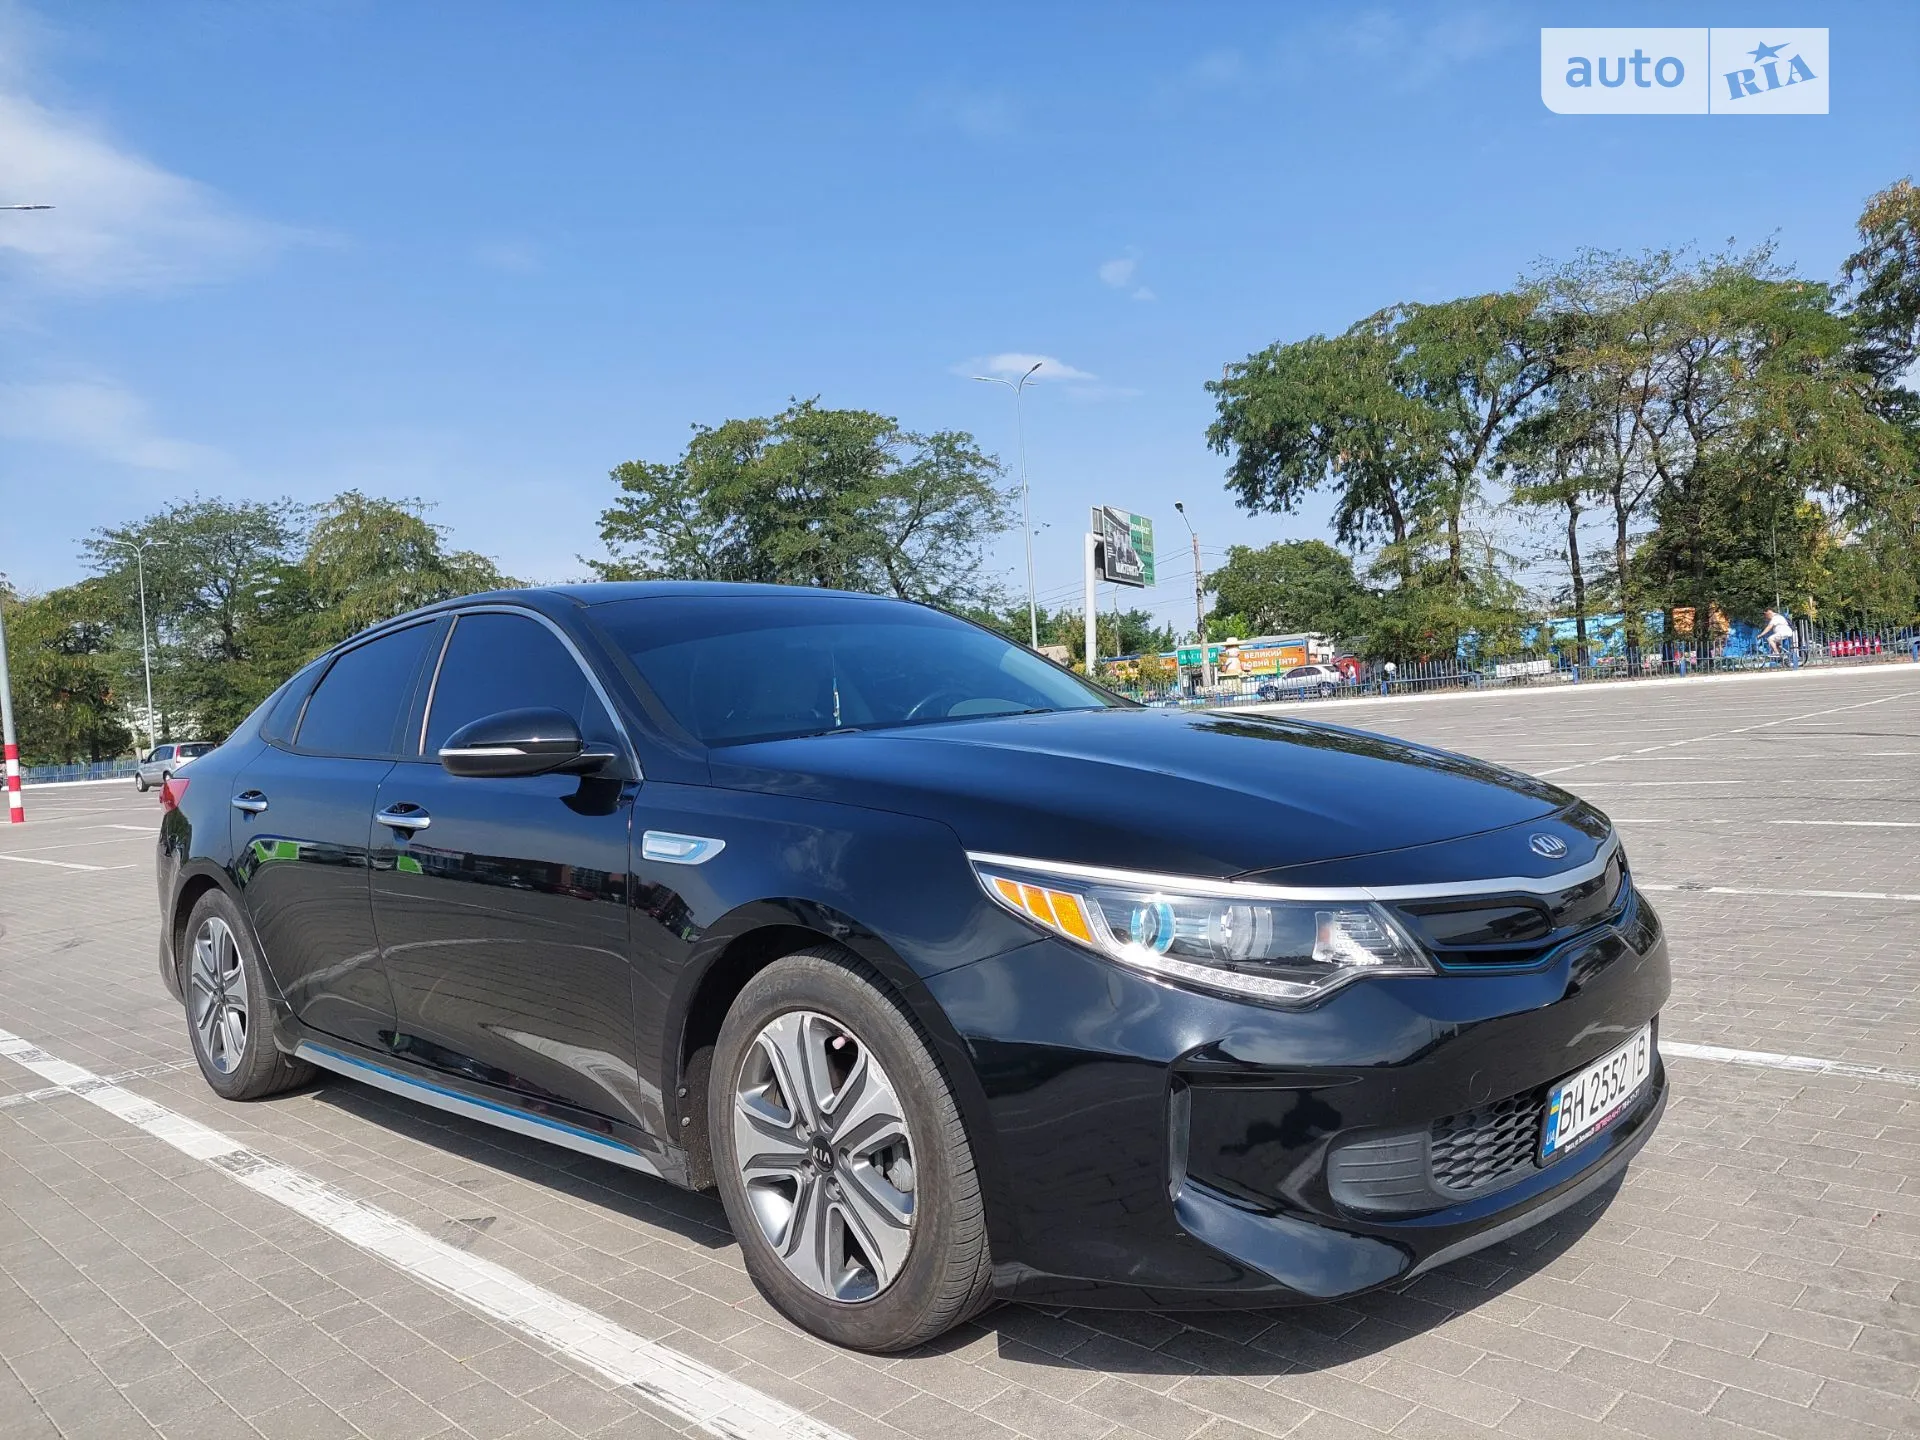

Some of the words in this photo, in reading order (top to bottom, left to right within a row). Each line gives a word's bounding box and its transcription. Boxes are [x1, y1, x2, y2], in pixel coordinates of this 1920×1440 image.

[1244, 648, 1282, 659] ВЕЛИКИЙ
[1533, 836, 1566, 853] KIA
[1559, 1078, 1586, 1137] BH
[1590, 1052, 1628, 1117] 2552
[813, 1145, 832, 1165] KIA
